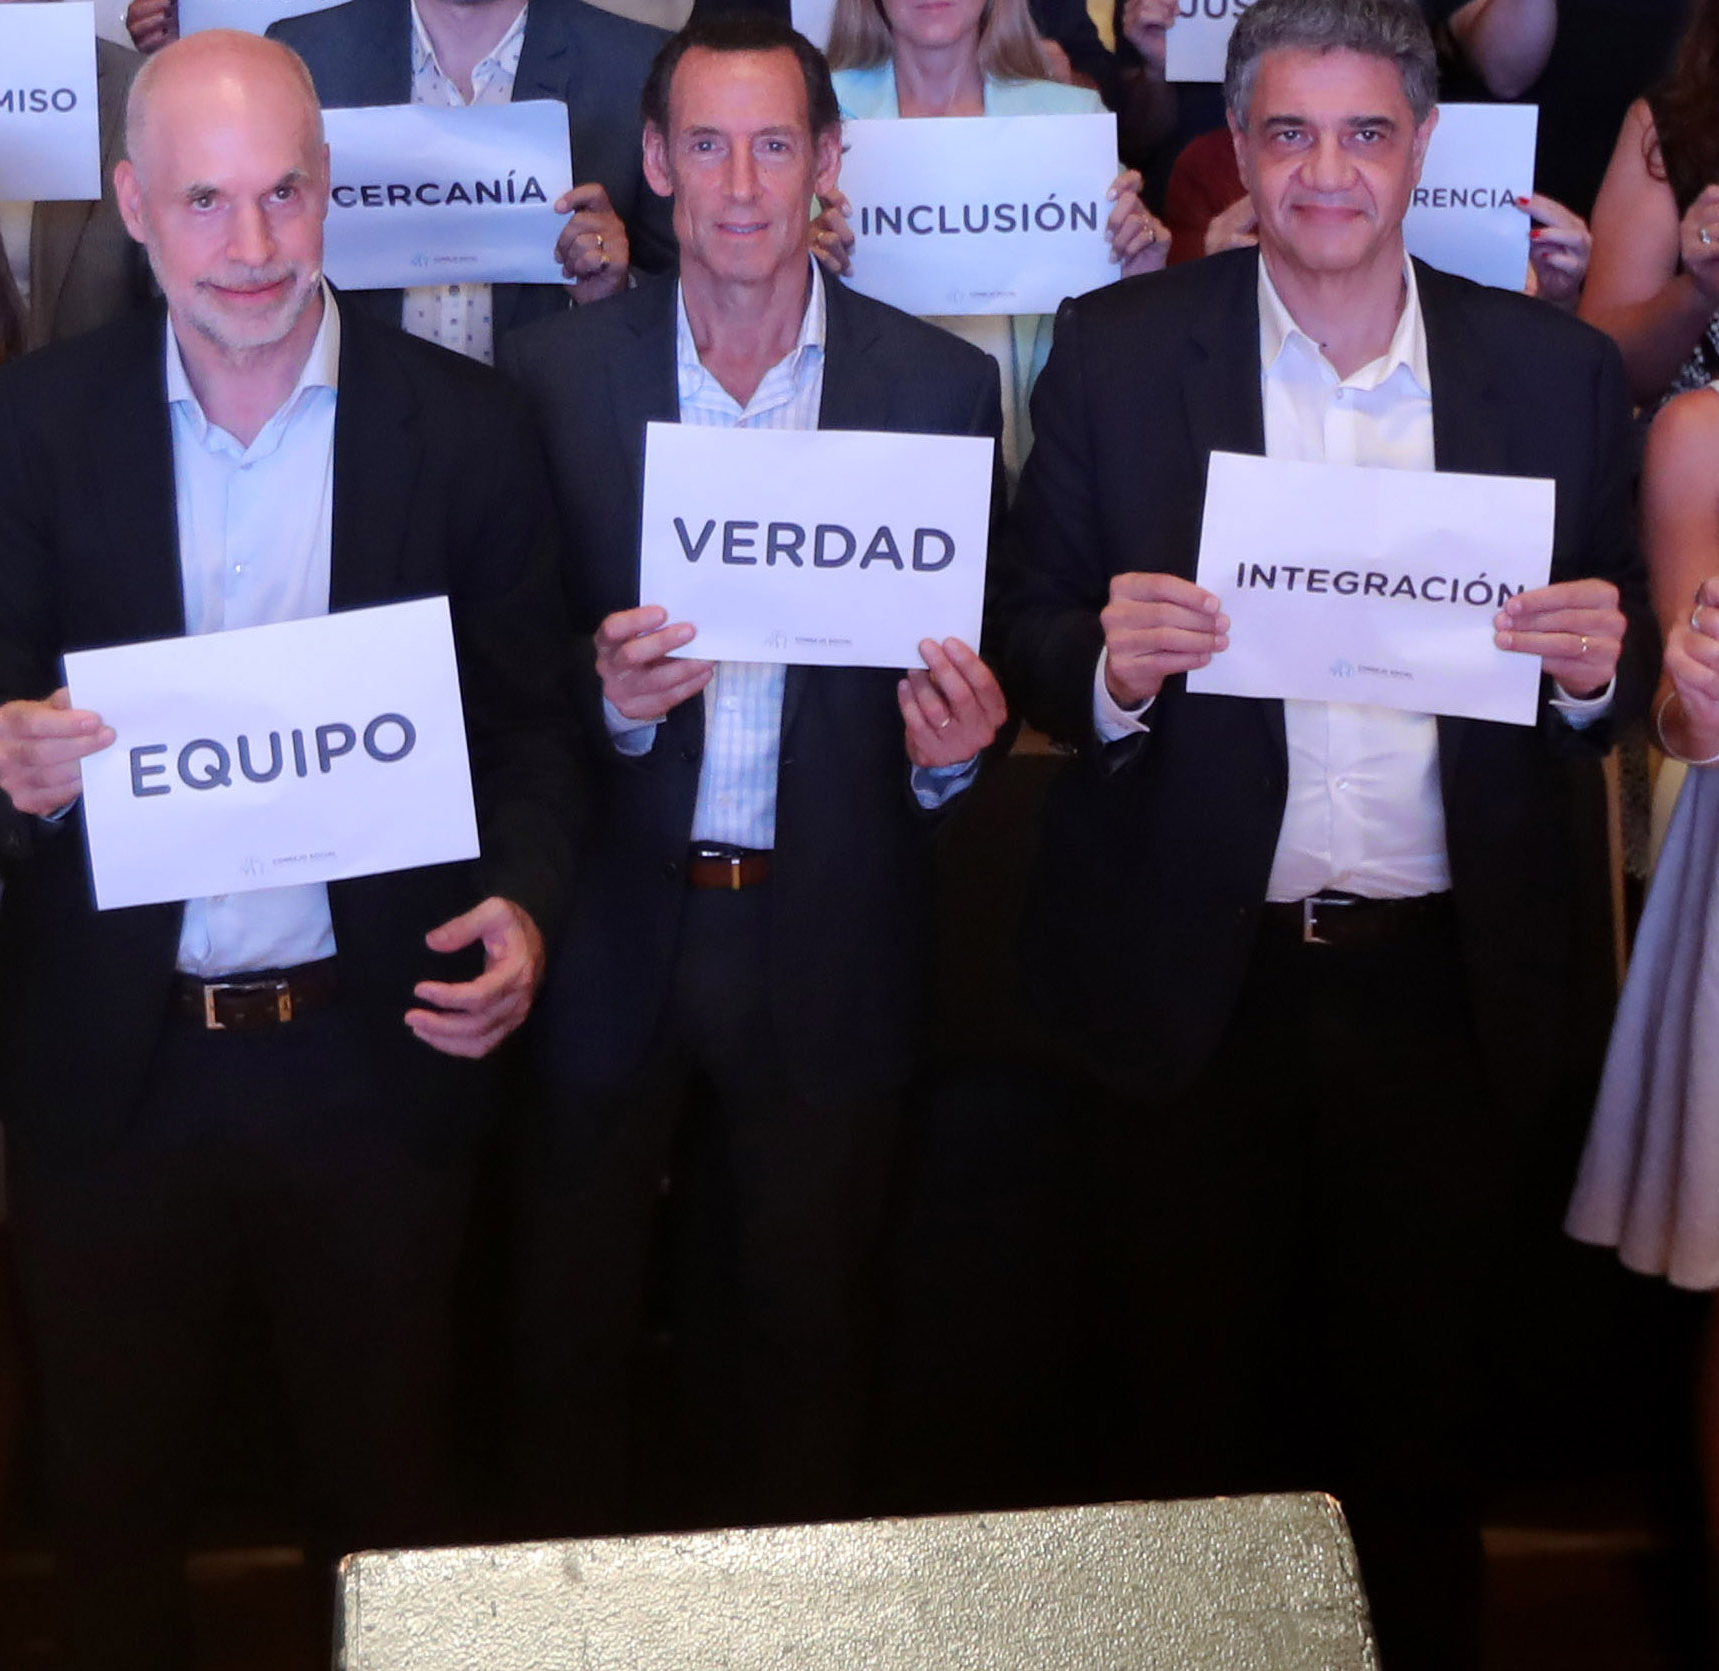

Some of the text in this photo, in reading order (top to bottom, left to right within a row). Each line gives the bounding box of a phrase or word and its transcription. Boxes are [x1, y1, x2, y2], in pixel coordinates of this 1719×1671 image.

[331, 169, 547, 209] CERCANÍA
[860, 193, 1099, 236] INCLUSIÓN
[672, 516, 957, 574] VERDAD
[1234, 561, 1527, 608] INTEGRACIÓN
[128, 710, 418, 800] EQUIPO
